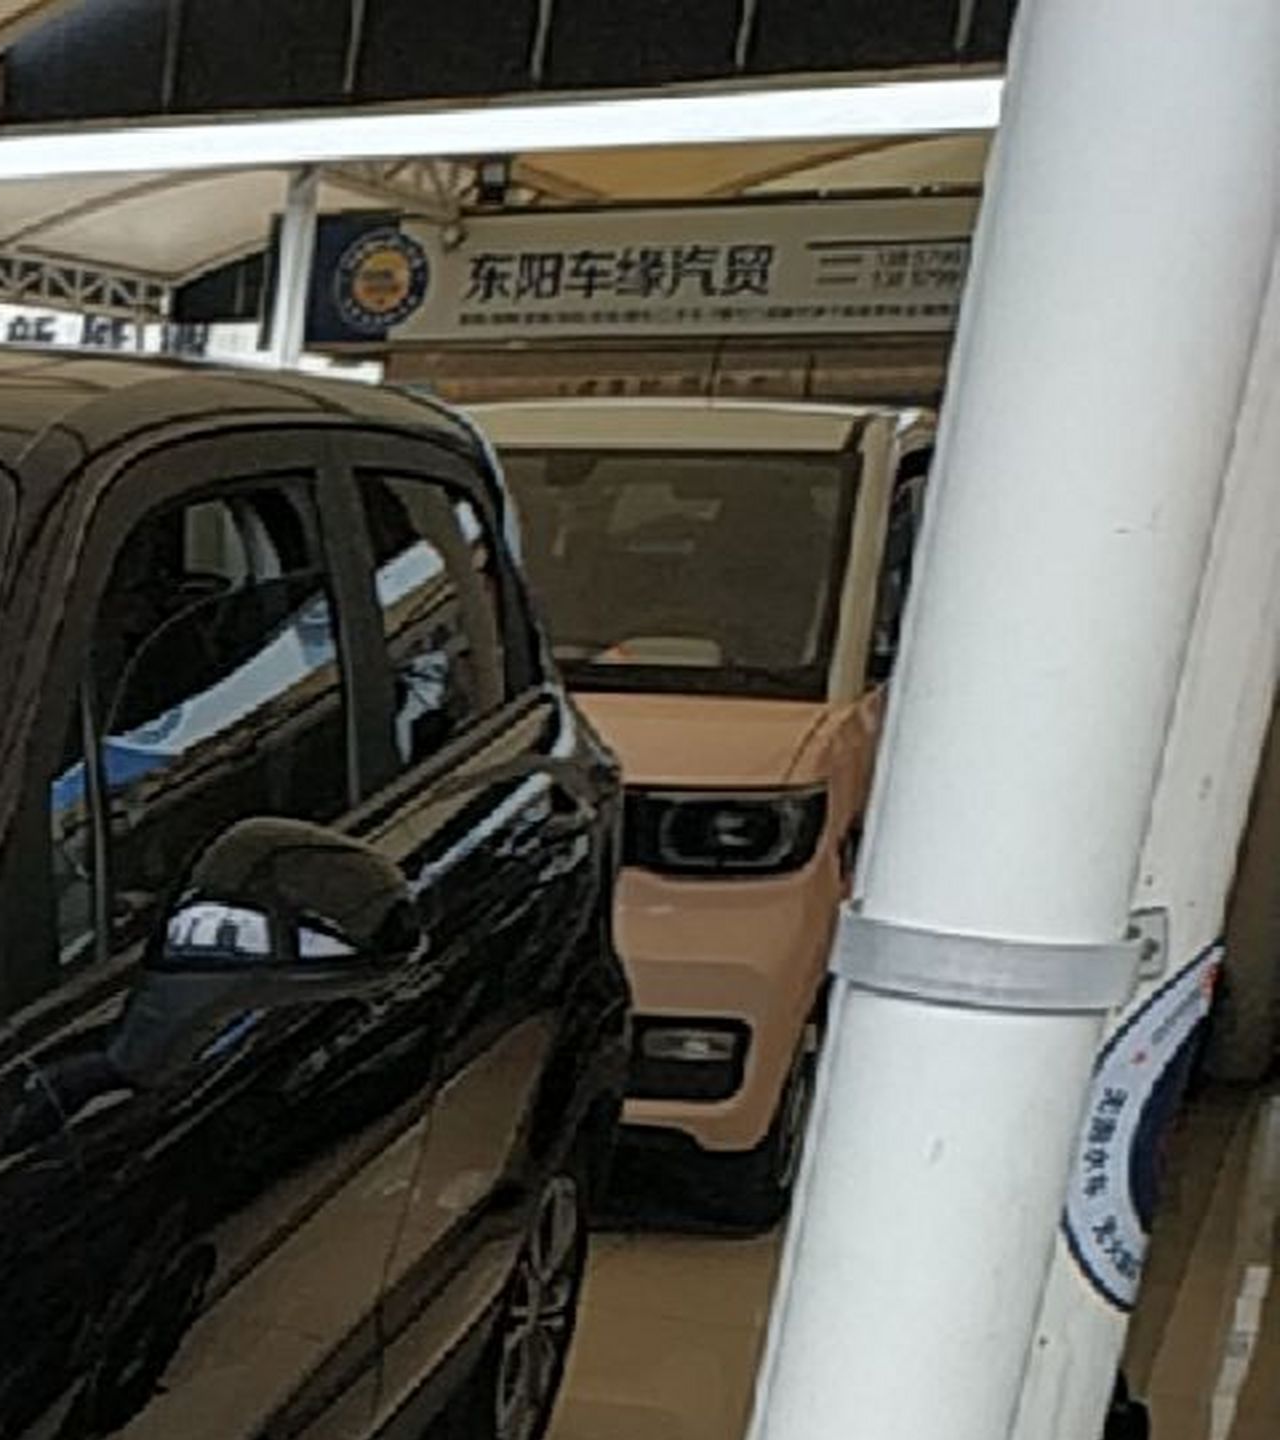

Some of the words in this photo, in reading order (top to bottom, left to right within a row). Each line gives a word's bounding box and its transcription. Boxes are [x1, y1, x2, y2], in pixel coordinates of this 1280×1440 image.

[466, 246, 773, 300] 东阳车缘汽贸
